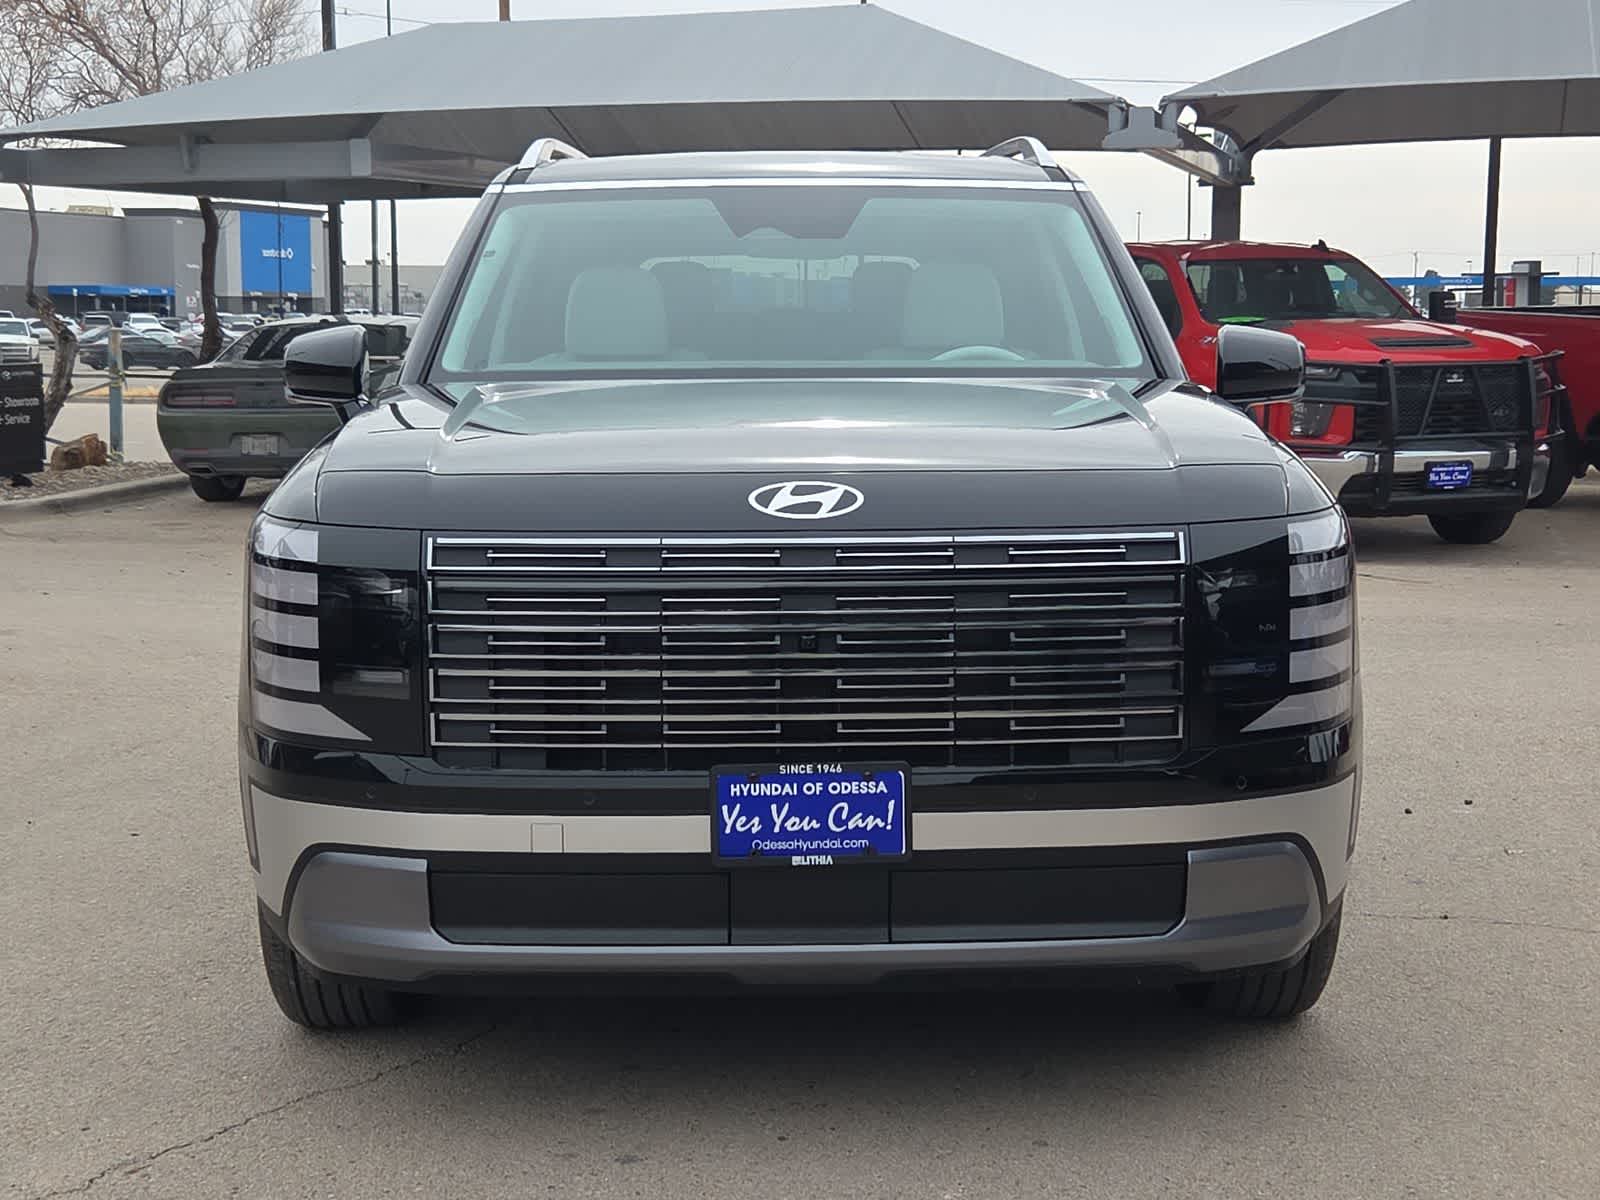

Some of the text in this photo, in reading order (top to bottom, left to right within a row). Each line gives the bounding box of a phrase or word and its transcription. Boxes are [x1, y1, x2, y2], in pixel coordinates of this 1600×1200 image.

[4, 397, 40, 408] Showroom
[4, 414, 31, 425] Service
[779, 763, 843, 775] SINCE 1946
[730, 781, 888, 797] HYUNDAI OF ODESSA
[721, 799, 896, 834] Yes You Can!
[751, 838, 869, 852] OdessaHyundai.com
[799, 855, 834, 866] LITHIA
